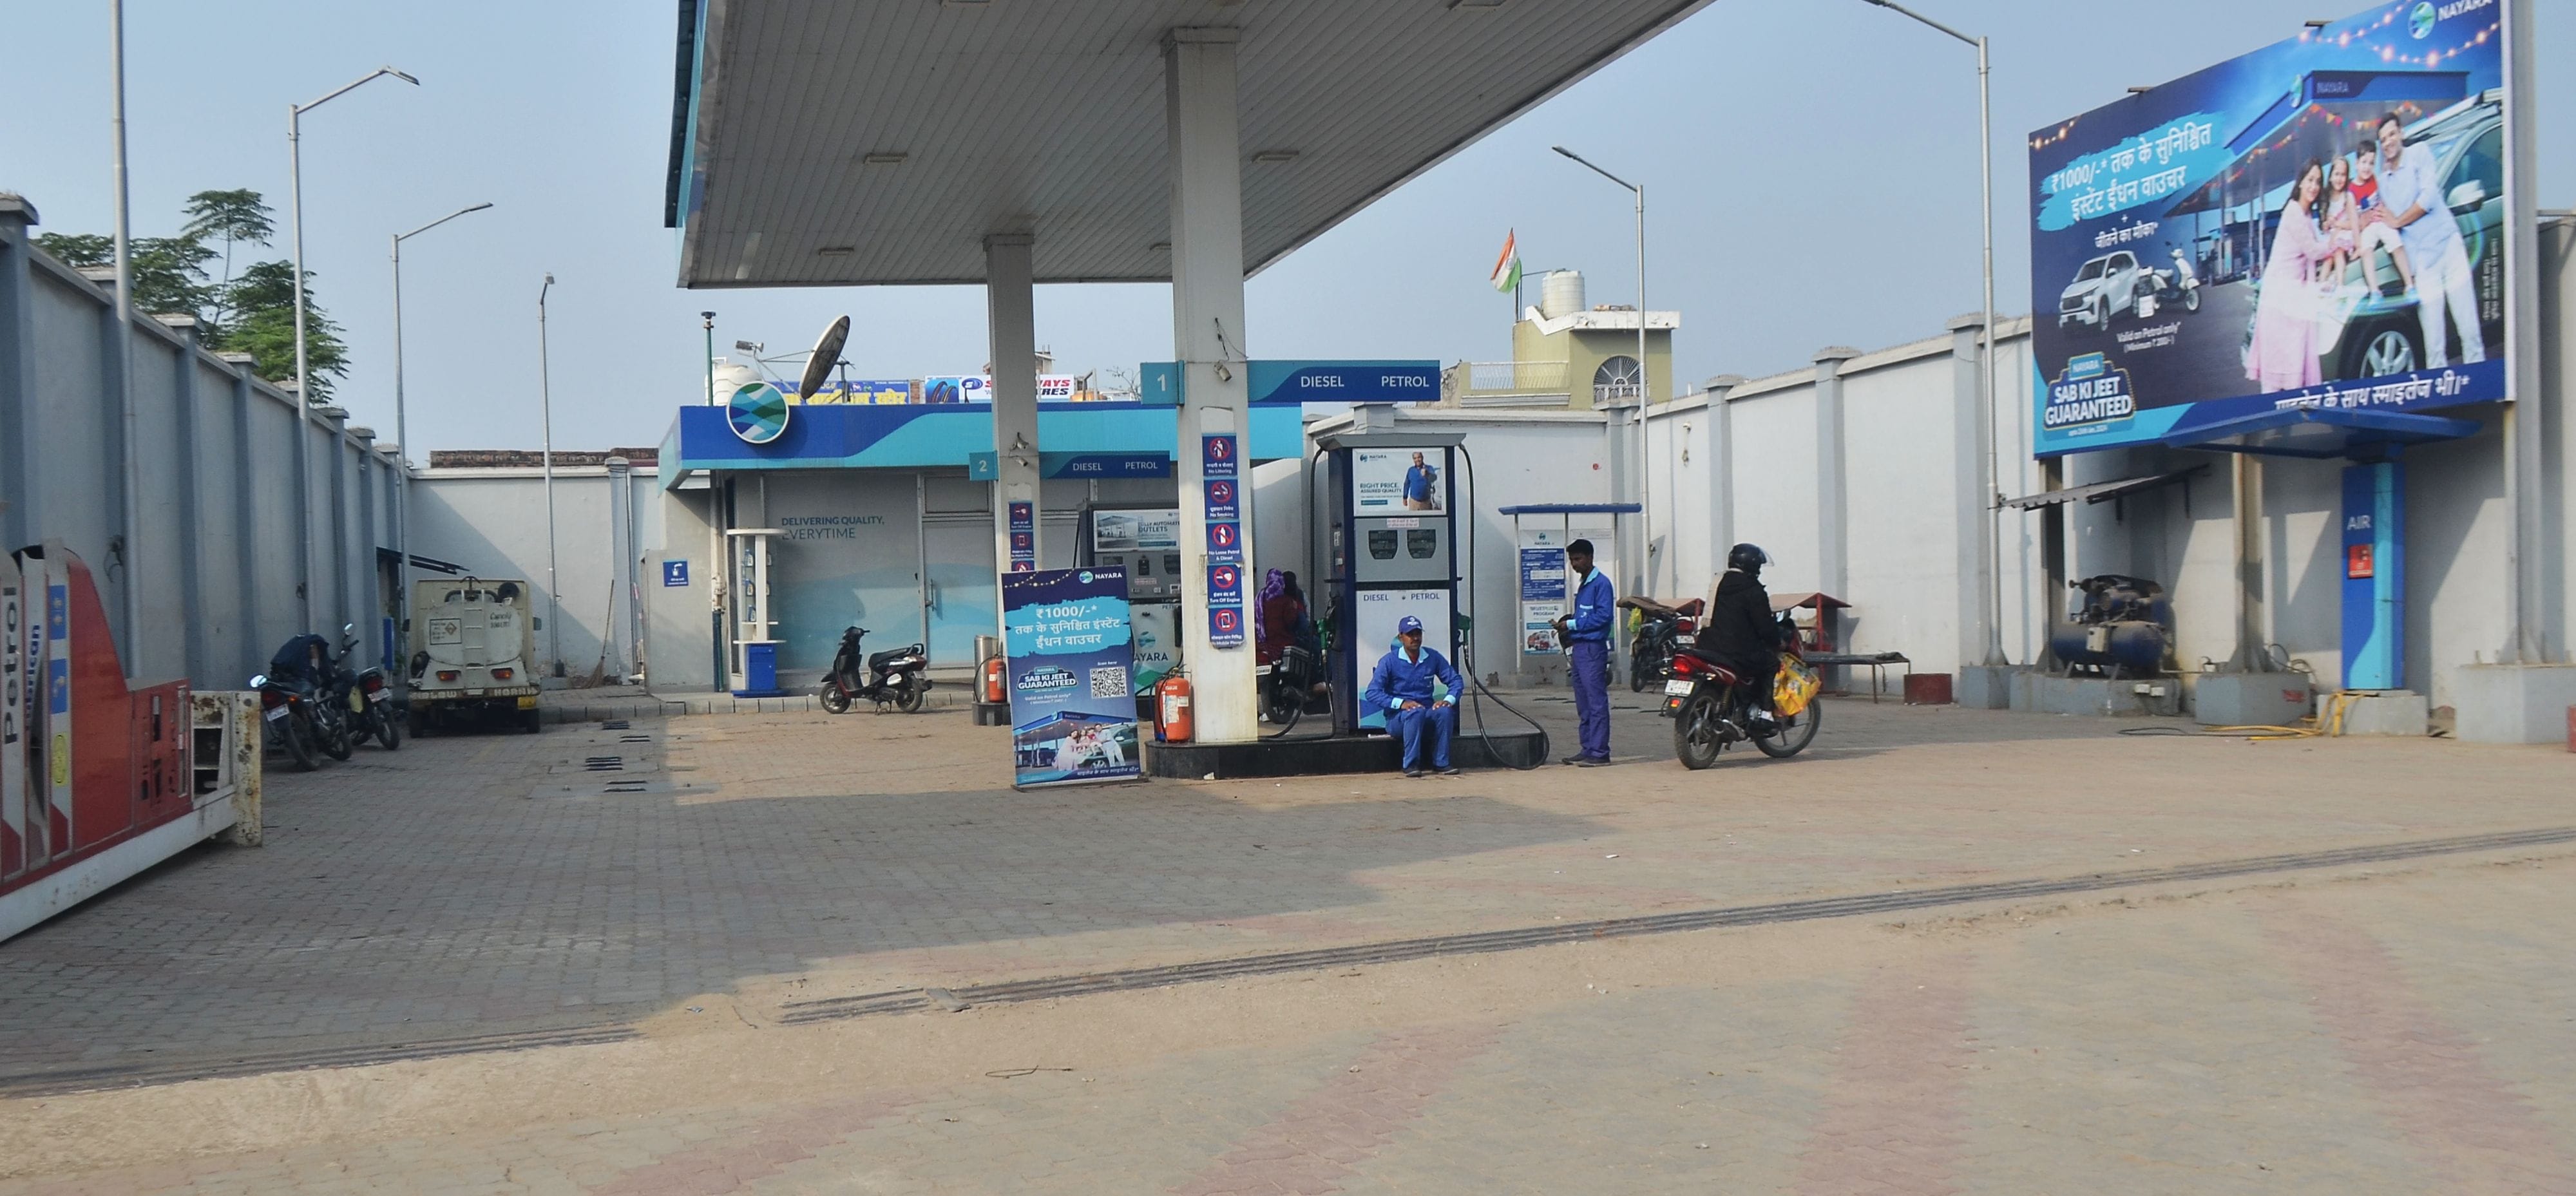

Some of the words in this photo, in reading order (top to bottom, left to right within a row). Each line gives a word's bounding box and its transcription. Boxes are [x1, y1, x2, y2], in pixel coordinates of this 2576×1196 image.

[2110, 147, 2135, 173] तक
[2138, 137, 2153, 164] के
[2141, 166, 2187, 196] वाउचर
[1039, 379, 1071, 387] AYS
[1157, 374, 1167, 392] 1
[1301, 375, 1345, 388] DIESEL
[1381, 375, 1429, 387] PETROL
[2054, 384, 2077, 404] SAB
[2079, 381, 2092, 400] KI
[2093, 376, 2121, 398] JEET
[2323, 386, 2339, 408] के
[2341, 388, 2371, 409] साथ
[2045, 394, 2133, 425] GUARANTEED
[978, 459, 987, 472] 2
[1073, 462, 1103, 471] DIESEL
[1125, 461, 1158, 470] PETROL
[781, 517, 839, 526] DELIVERING
[841, 516, 884, 526] QUALITY,
[2347, 515, 2371, 531] AIR
[1095, 571, 1123, 580] NAYARA
[1015, 625, 1033, 635] तक
[1036, 622, 1046, 633] के
[1065, 634, 1103, 646] वाउचर
[1134, 652, 1169, 661] AYARA
[3, 587, 17, 745] Petrol
[1018, 678, 1076, 690] GUARANTEED
